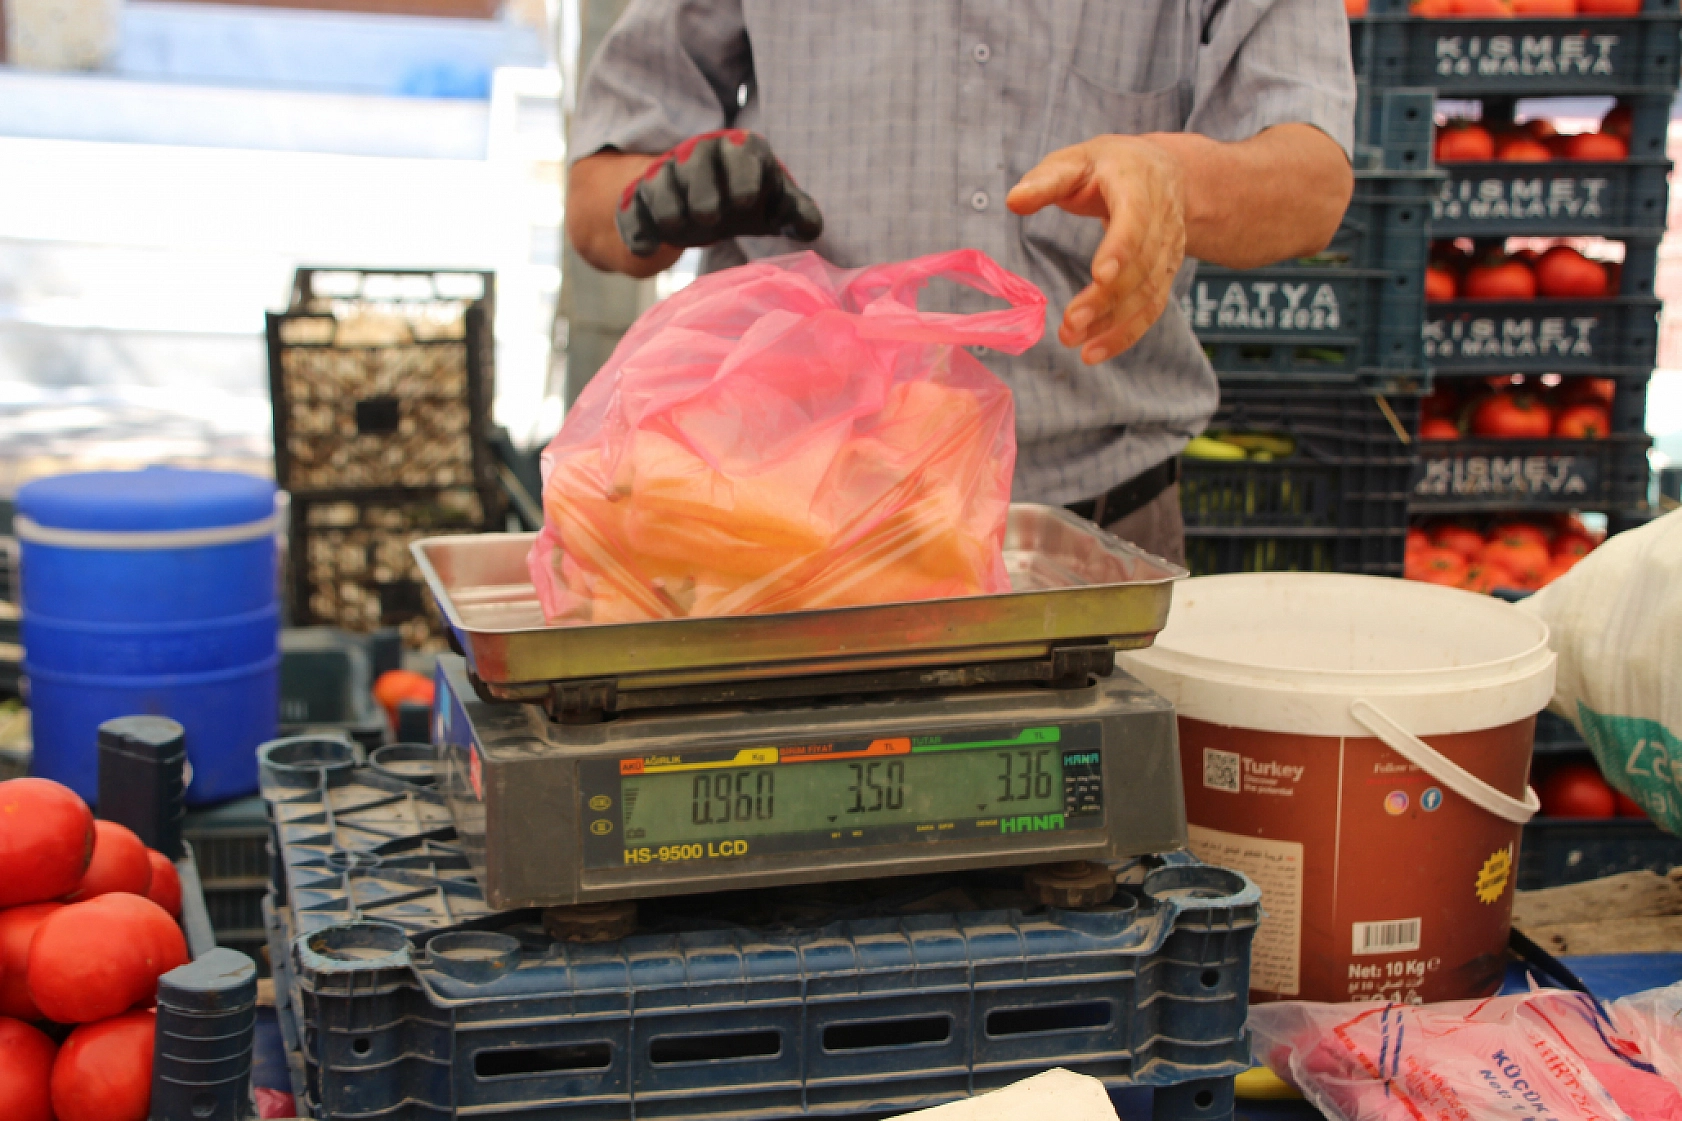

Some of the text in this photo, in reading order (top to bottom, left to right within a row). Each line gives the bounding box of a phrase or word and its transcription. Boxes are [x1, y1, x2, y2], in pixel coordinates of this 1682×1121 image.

[1436, 35, 1619, 58] KISMET
[1478, 56, 1613, 75] MALATYA
[1469, 199, 1600, 219] MALATYA
[1280, 309, 1340, 330] 2024
[1422, 317, 1597, 341] KISMET
[1461, 337, 1593, 357] MALATYA
[1426, 456, 1574, 481] KISMET
[1063, 752, 1100, 767] HANA
[1242, 757, 1305, 783] Turkey
[1001, 813, 1065, 834] HANA
[623, 839, 748, 865] HS-9500 LCD
[1347, 958, 1426, 981] Net: 10 Kg
[1491, 1049, 1549, 1112] KÜÇÜK
